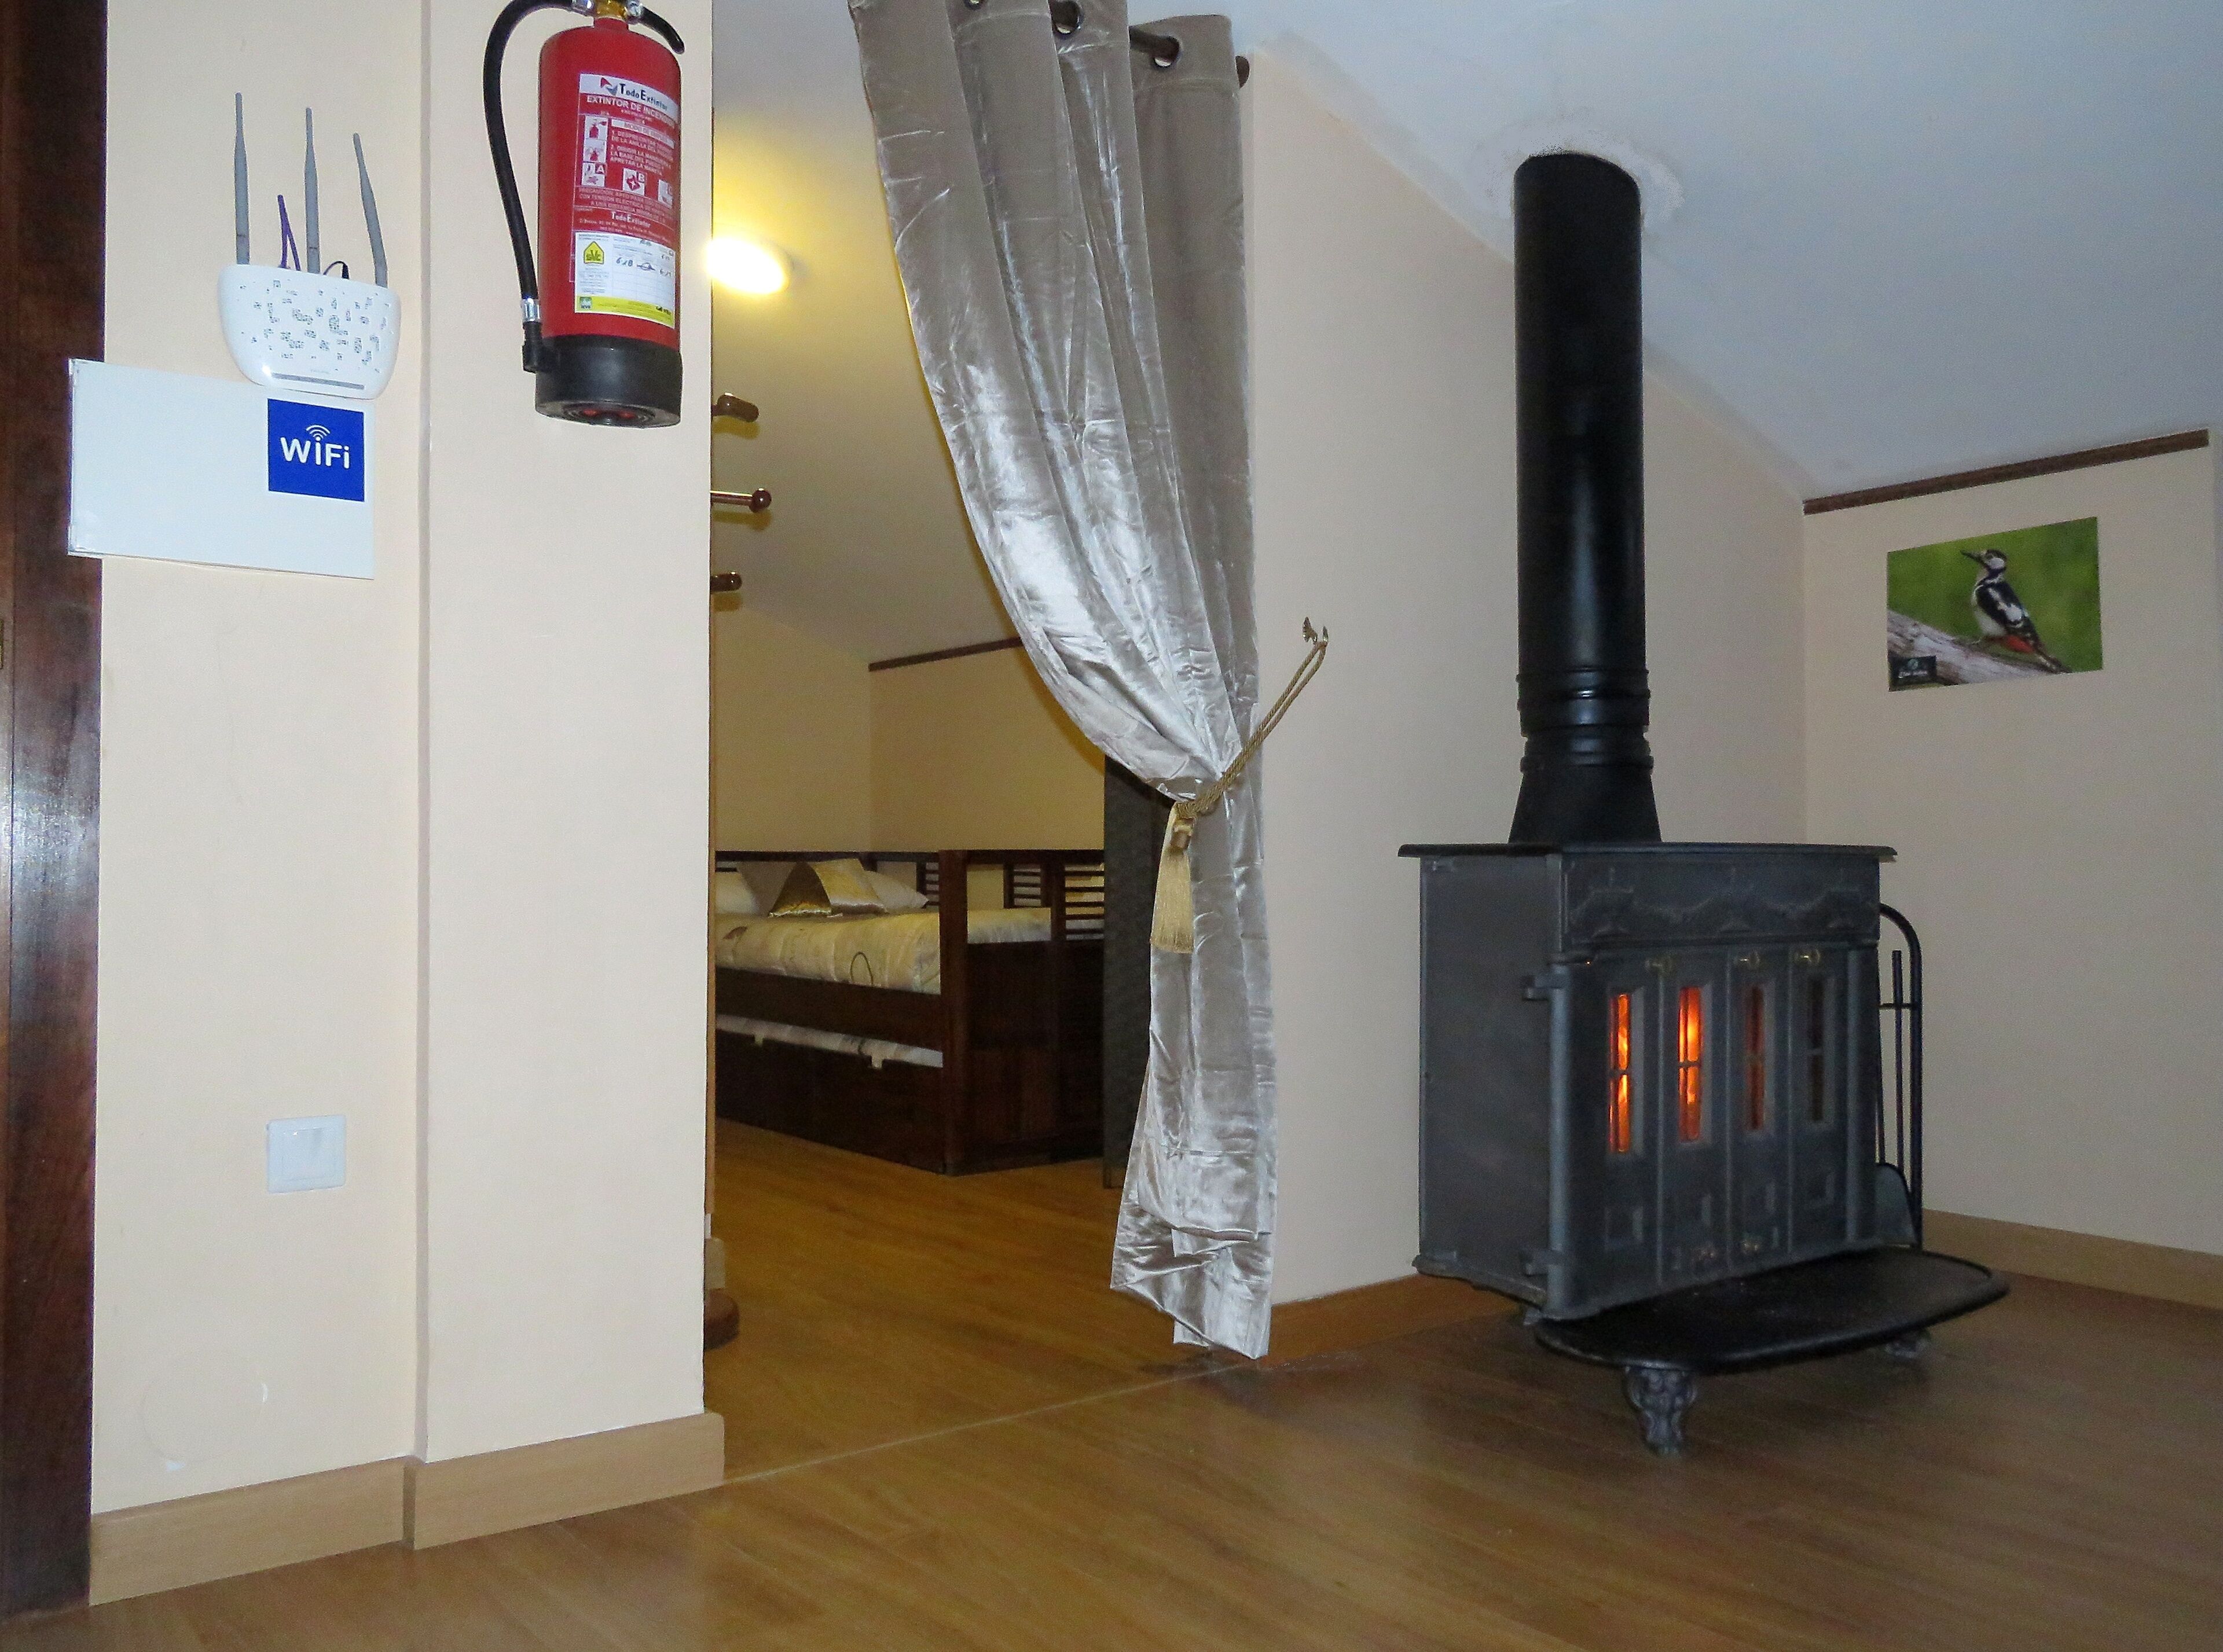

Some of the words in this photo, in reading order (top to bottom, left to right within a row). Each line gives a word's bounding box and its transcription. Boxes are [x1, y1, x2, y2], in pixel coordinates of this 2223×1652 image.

[587, 96, 629, 109] EXTINTOR
[630, 102, 642, 112] DE
[597, 166, 605, 174] A
[638, 173, 645, 182] B
[280, 436, 350, 469] WiFi
